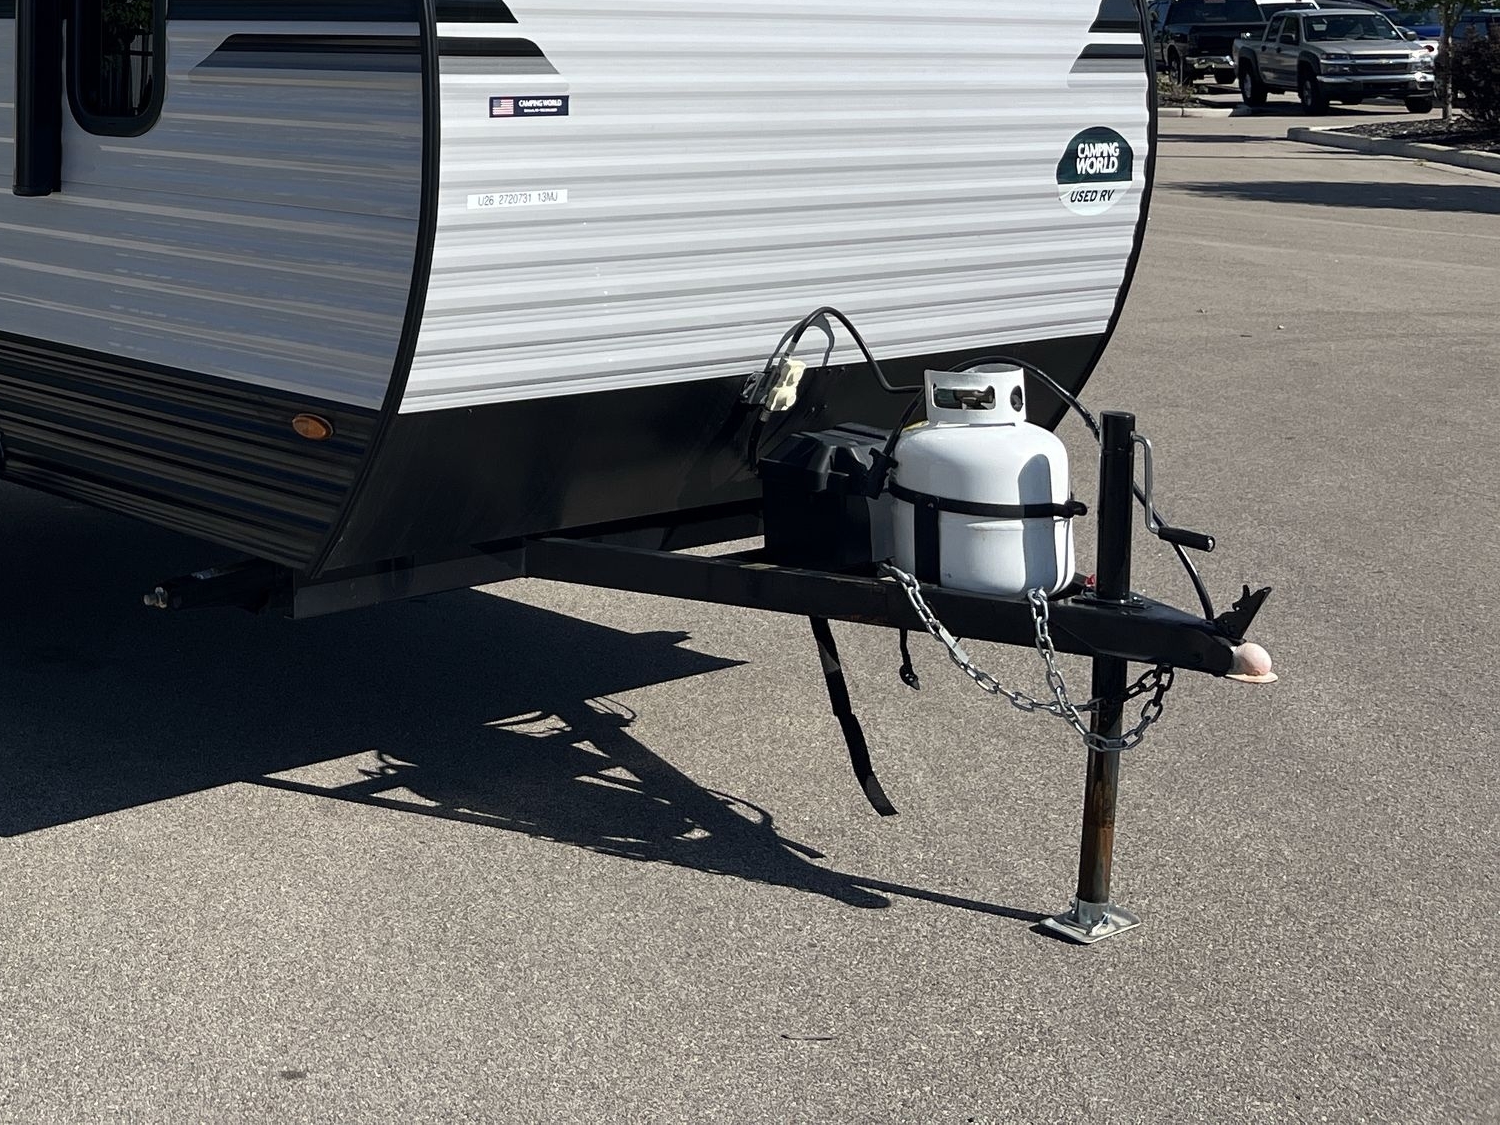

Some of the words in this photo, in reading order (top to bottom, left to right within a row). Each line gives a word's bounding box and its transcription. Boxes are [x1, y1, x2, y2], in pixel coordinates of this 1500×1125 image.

[1077, 142, 1119, 157] CAMPING
[1076, 156, 1118, 175] WORLD
[477, 195, 494, 206] U26
[498, 193, 532, 205] 2720731
[537, 191, 558, 203] 13MJ
[1070, 189, 1098, 203] USED
[1099, 189, 1115, 202] RV
